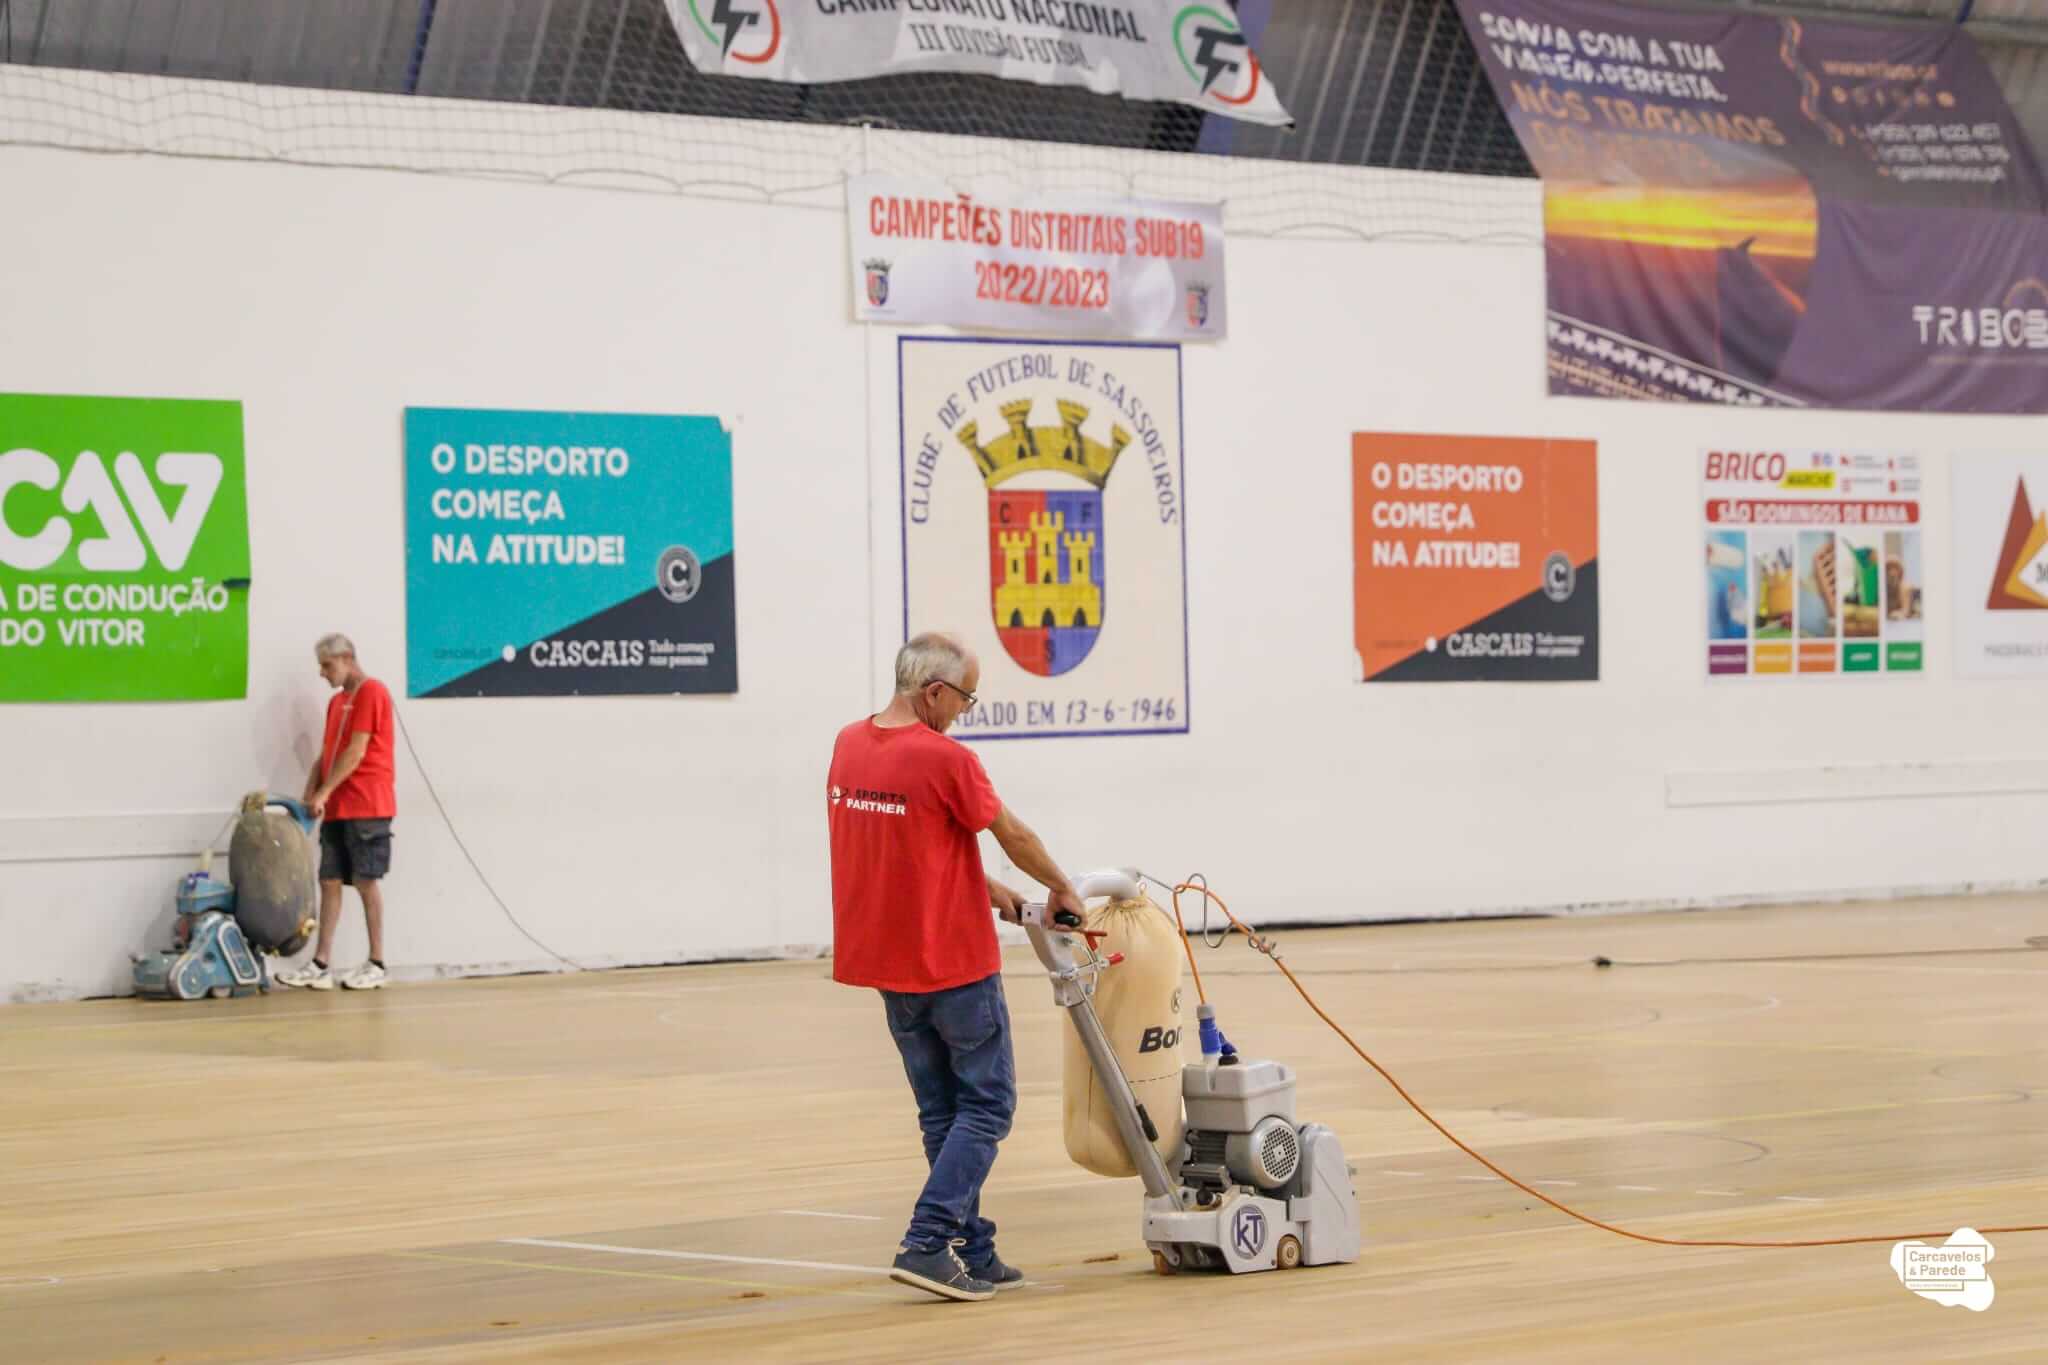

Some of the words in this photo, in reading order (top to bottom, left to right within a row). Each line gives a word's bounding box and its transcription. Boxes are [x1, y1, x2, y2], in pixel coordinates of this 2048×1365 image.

[909, 23, 940, 51] III
[1012, 0, 1147, 43] NACIONAL
[1578, 29, 1644, 62] COM
[1647, 39, 1669, 66] A
[1669, 40, 1724, 72] TUA
[869, 193, 1001, 247] CAMPEÕES
[1010, 208, 1126, 256] DISTRITAIS
[1135, 218, 1205, 260] SUB19
[975, 259, 1110, 310] 2022/2023
[910, 433, 943, 524] CLUBE
[938, 392, 966, 430] DE
[966, 353, 1058, 402] FUTEBOL
[1067, 357, 1094, 388] DE
[1098, 371, 1178, 526] SASSOEIROS
[431, 443, 456, 474] O
[465, 444, 630, 477] DESPORTO
[1705, 451, 1786, 481] BRICO
[1371, 462, 1392, 489] O
[1397, 463, 1524, 493] DESPORTO
[431, 489, 566, 525] COMEÇA
[1371, 501, 1475, 533] COMEÇA
[432, 534, 480, 564] NA
[485, 534, 626, 566] ATITUDE!
[1372, 540, 1408, 567] NA
[1414, 541, 1521, 568] ATITUDE!
[17, 584, 57, 612] DE
[63, 577, 229, 617] CONDUÇÃO
[57, 618, 145, 647] VITOR
[1446, 632, 1534, 657] CASCAIS
[529, 639, 646, 668] CASCAIS
[1027, 700, 1055, 726] EM
[847, 798, 906, 815] PARTNER
